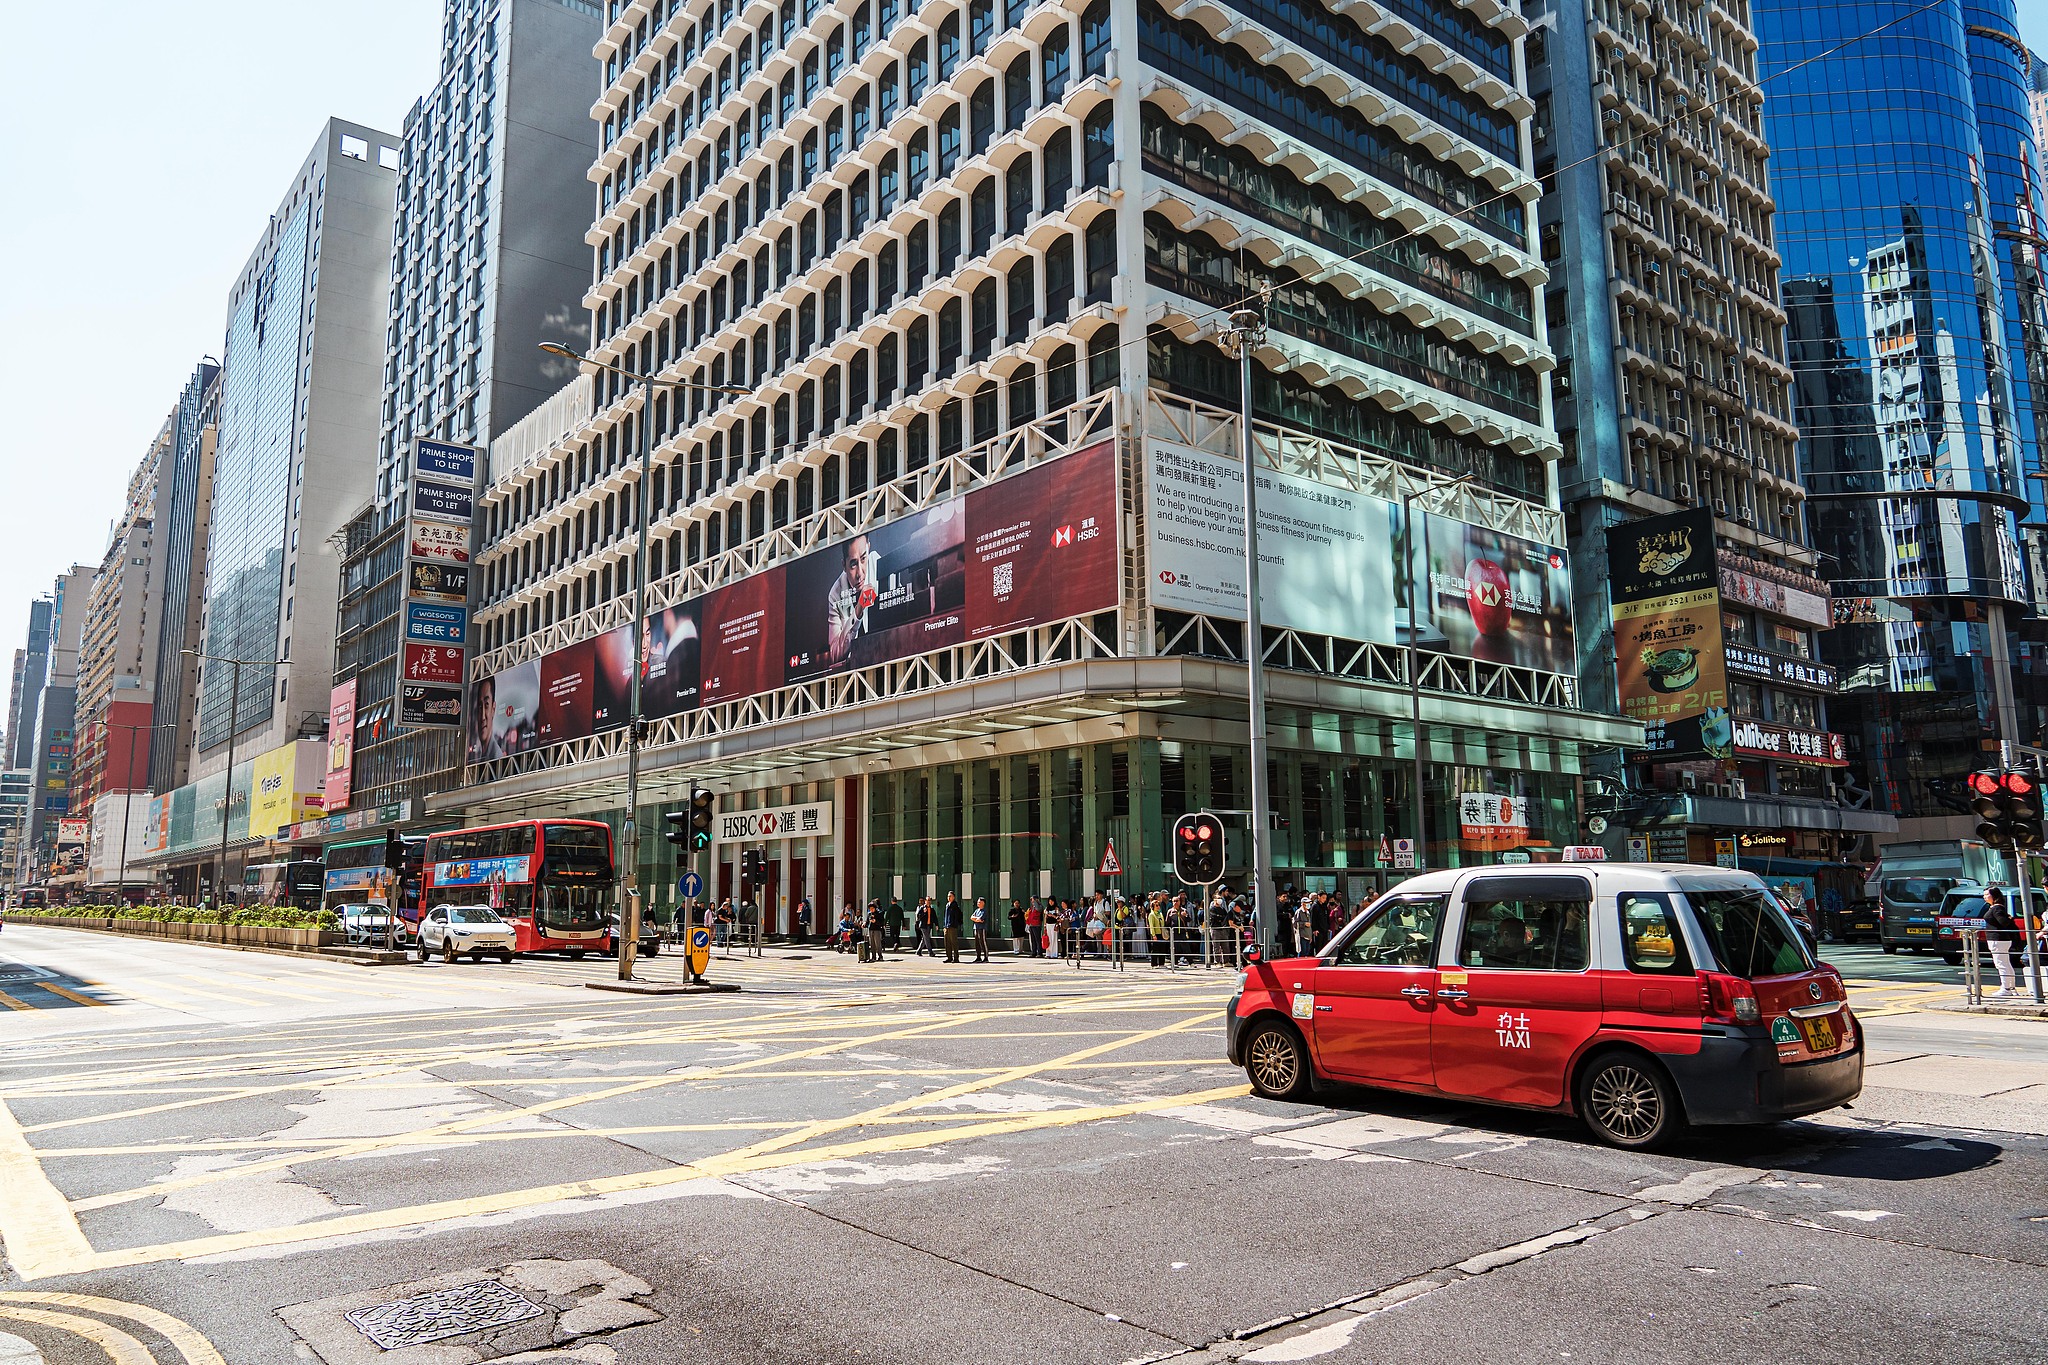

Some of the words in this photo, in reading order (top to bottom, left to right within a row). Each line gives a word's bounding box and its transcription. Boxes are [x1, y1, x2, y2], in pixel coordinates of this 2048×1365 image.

[421, 447, 446, 458] PRIME
[447, 451, 474, 463] SHOPS
[434, 459, 446, 468] TO
[448, 461, 461, 470] LET
[418, 487, 444, 498] PRIME
[445, 491, 472, 502] SHOPS
[432, 500, 444, 508] TO
[445, 501, 458, 510] LET
[1156, 483, 1171, 496] We
[1172, 488, 1186, 499] are
[1188, 490, 1232, 513] introducing
[1234, 504, 1239, 512] a
[1259, 508, 1291, 525] business
[1292, 518, 1321, 532] account
[1322, 523, 1345, 537] fitness
[1345, 531, 1365, 542] guide
[1156, 497, 1166, 507] to
[1167, 498, 1186, 512] help
[1187, 504, 1202, 515] you
[1204, 507, 1226, 521] begin
[1228, 514, 1245, 525] your
[1281, 525, 1305, 539] fitness
[1306, 530, 1332, 546] journey
[1157, 511, 1173, 521] and
[1175, 513, 1206, 528] achieve
[1207, 521, 1225, 532] your
[1077, 527, 1100, 542] HSBC
[1635, 529, 1686, 554] 喜亭軒
[433, 545, 448, 557] 4F
[445, 573, 466, 588] 1/F
[1176, 580, 1192, 588] HSBC
[1195, 583, 1213, 594] Opening
[1445, 588, 1466, 599] account
[1515, 603, 1536, 613] business
[1624, 604, 1640, 614] 3/F
[1669, 596, 1689, 606] 2521
[1692, 592, 1713, 602] 1688
[418, 611, 455, 621] watsons
[924, 618, 946, 632] Premier
[946, 615, 959, 627] Elite
[411, 623, 445, 637] 屈臣氏
[1638, 623, 1697, 643] 烤魚工房
[1731, 661, 1744, 670] FISH
[1743, 663, 1757, 673] GONG
[1757, 666, 1771, 675] FANG
[1783, 661, 1828, 686] 烤魚工房
[404, 687, 425, 698] 5/F
[676, 688, 689, 698] Premier
[1684, 690, 1724, 709] 2/F
[1787, 730, 1823, 758] 快樂蜂
[722, 814, 757, 838] HSBC
[779, 808, 819, 833] 滙豐
[1752, 835, 1787, 844] Jollibee
[1576, 847, 1603, 860] TAXI
[1496, 1011, 1531, 1030] 的士
[1782, 1024, 1789, 1034] 4
[1495, 1030, 1531, 1049] TAXI
[1778, 1034, 1797, 1042] SEATS
[1810, 1031, 1834, 1049] 7520
